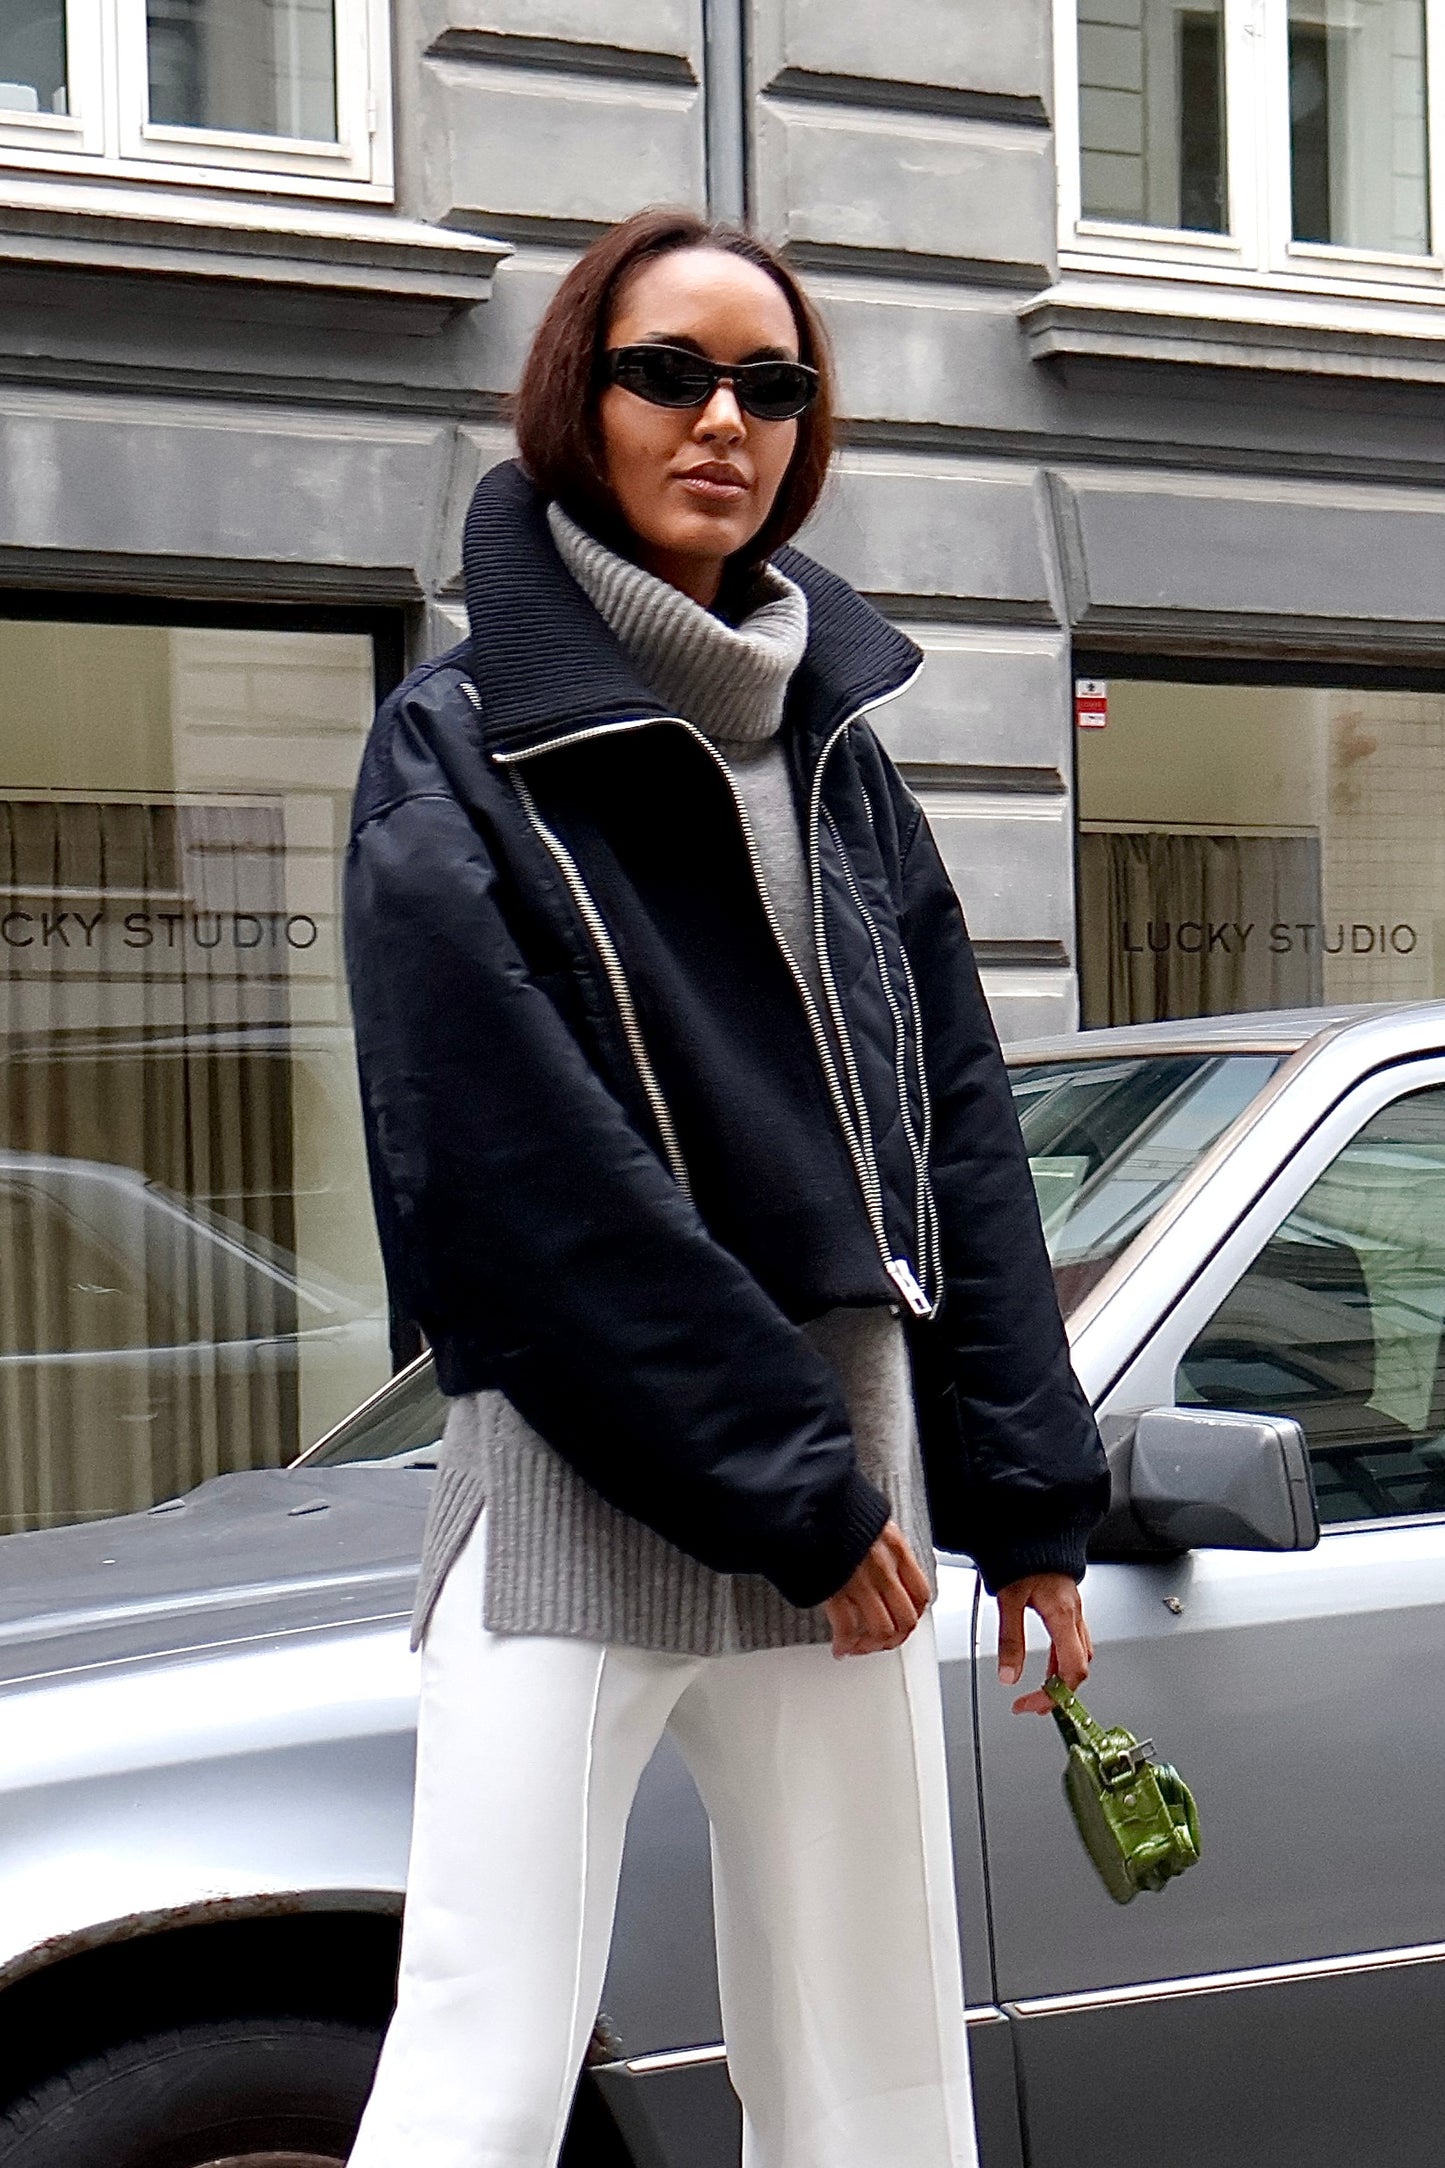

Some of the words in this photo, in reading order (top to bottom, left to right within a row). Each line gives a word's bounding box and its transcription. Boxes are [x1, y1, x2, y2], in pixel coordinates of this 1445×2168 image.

[1, 911, 103, 948] CKY
[123, 912, 317, 949] STUDIO
[1123, 921, 1254, 953] LUCKY
[1269, 923, 1417, 954] STUDIO
